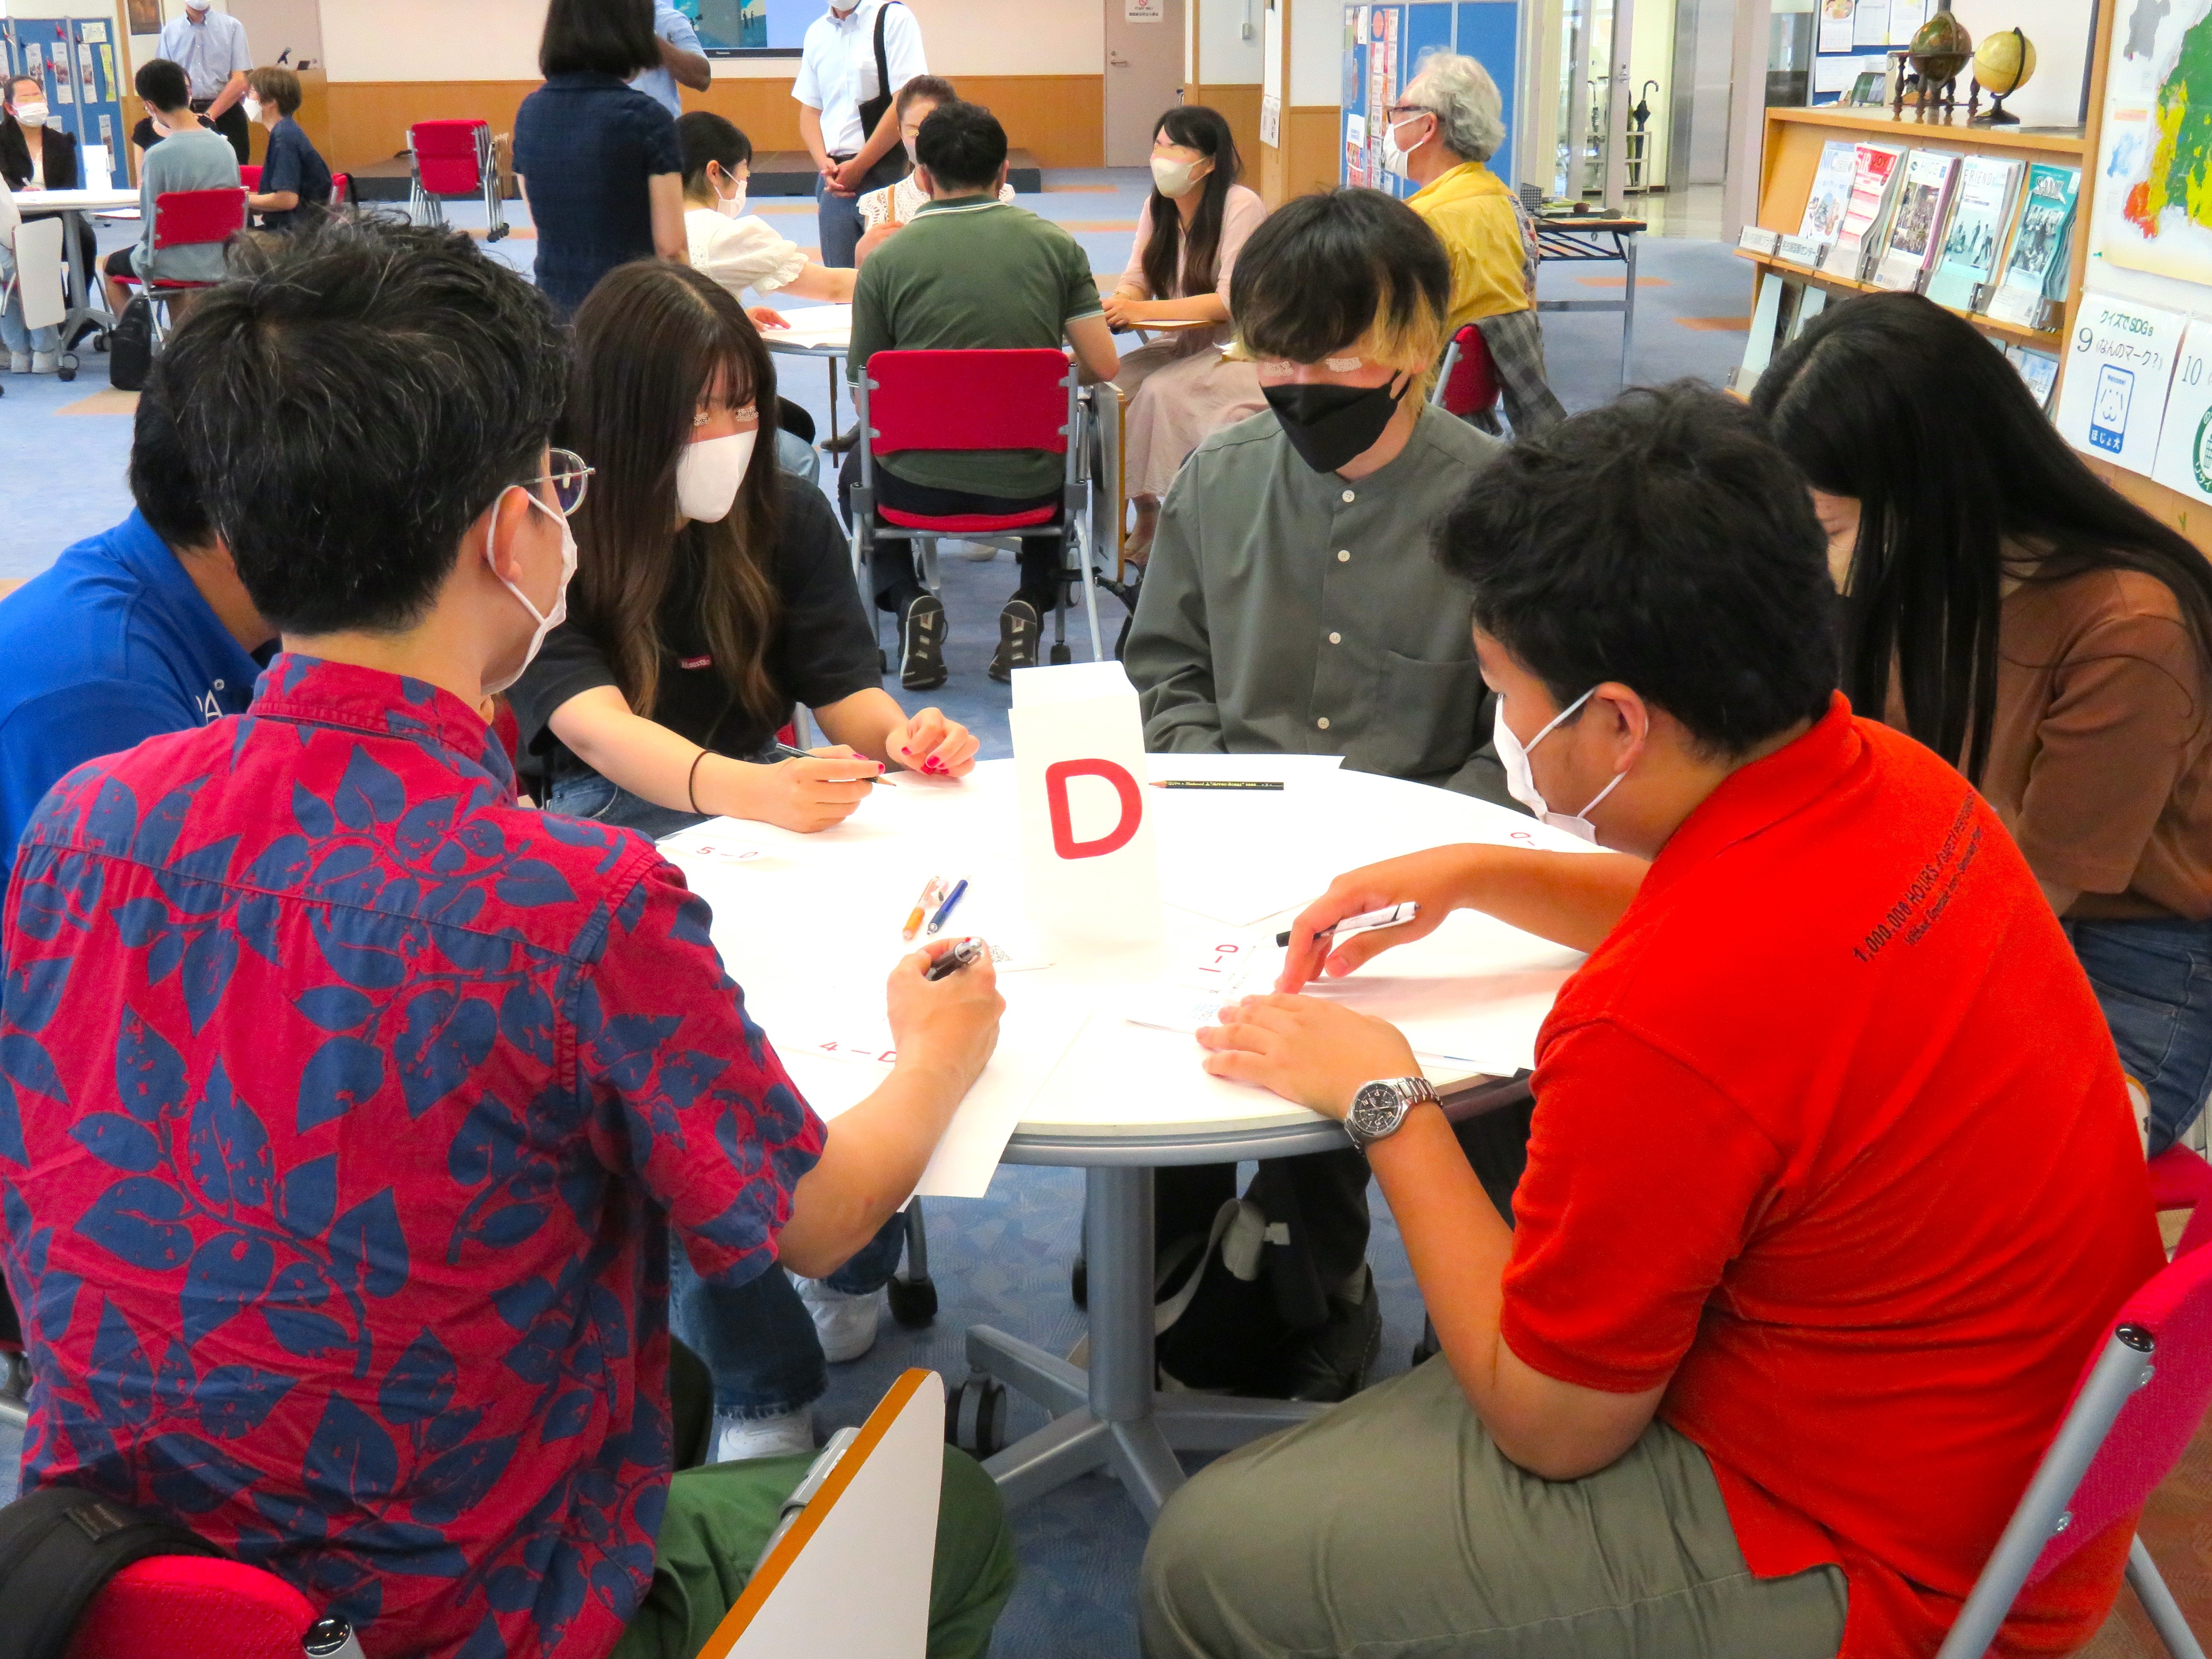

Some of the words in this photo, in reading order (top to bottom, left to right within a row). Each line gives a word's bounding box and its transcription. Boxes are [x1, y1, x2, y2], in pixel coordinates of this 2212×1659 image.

[2077, 327, 2093, 352] 9
[2181, 355, 2202, 385] 10
[1045, 757, 1143, 860] D
[1905, 864, 1940, 905] HOURS
